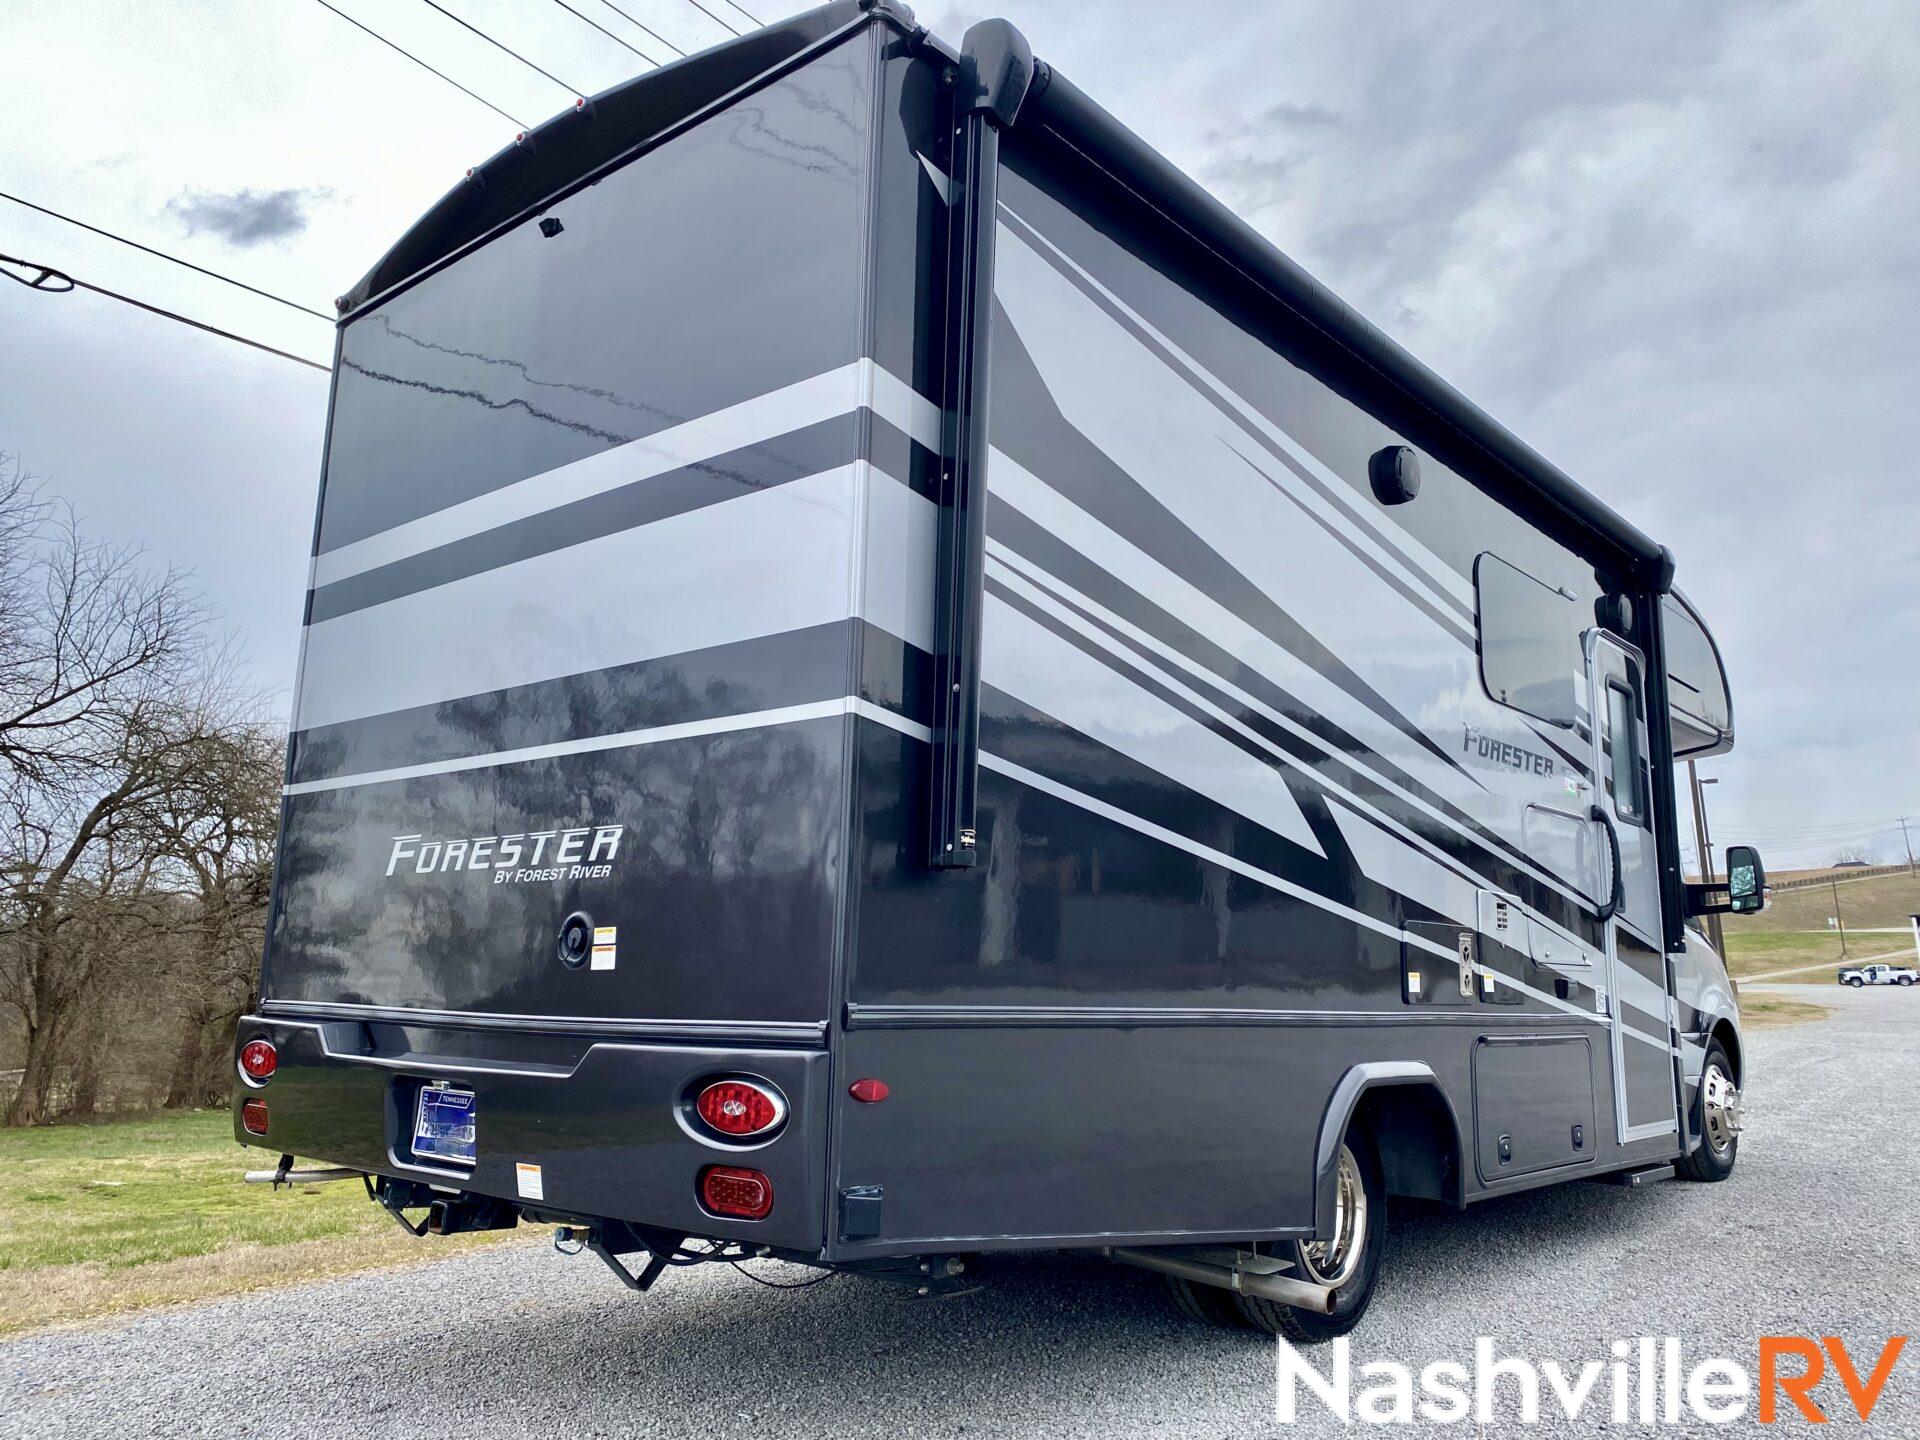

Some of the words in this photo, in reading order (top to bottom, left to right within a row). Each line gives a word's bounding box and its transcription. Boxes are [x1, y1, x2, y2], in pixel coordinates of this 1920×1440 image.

[1462, 722, 1554, 777] FORESTER
[385, 825, 624, 877] FORESTER
[494, 870, 513, 884] BY
[514, 868, 567, 882] FOREST
[569, 864, 612, 879] RIVER
[442, 1095, 468, 1105] TENNESSEE
